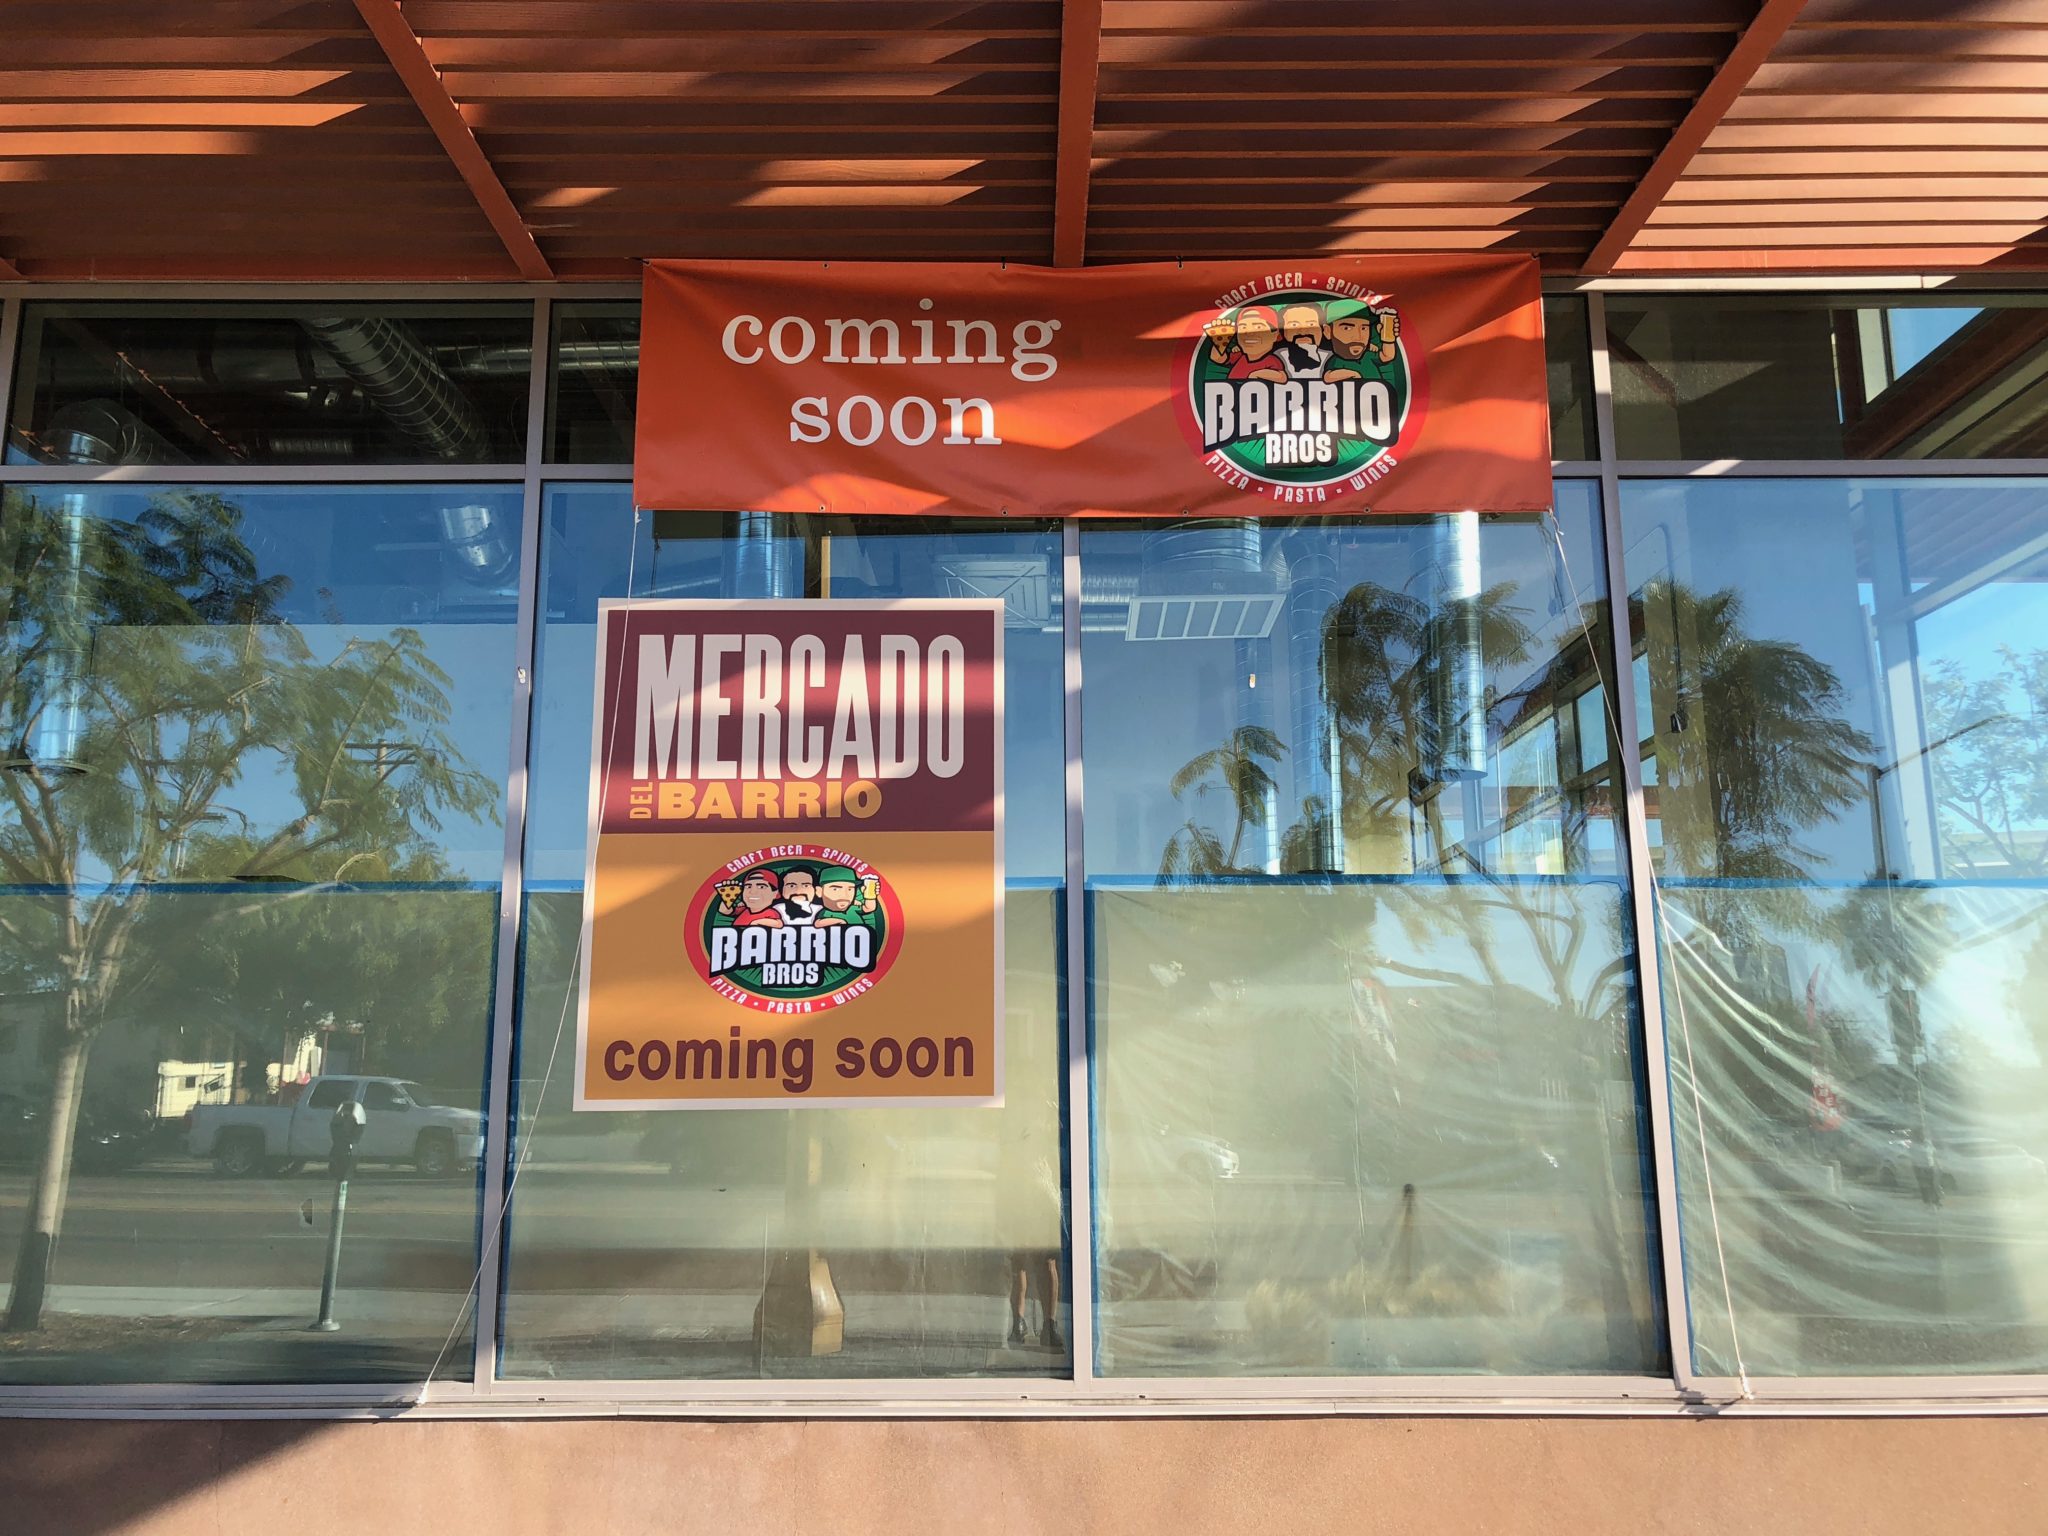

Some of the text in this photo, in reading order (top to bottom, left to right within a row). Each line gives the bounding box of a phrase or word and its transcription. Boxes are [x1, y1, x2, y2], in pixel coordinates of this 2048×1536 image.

[1214, 272, 1383, 309] CRAFT BEER SPIRITS
[722, 298, 1061, 382] coming
[789, 394, 1002, 447] soon
[1204, 380, 1392, 447] BARRIO
[1265, 433, 1332, 465] BROS
[1205, 454, 1398, 503] PIZZA PASTA WINGS
[632, 634, 965, 780] MERCADO
[629, 780, 882, 819] DEL BARRIO
[726, 844, 869, 873] CRAFT BEER SPIRITS
[710, 925, 871, 973] BARRIO
[710, 977, 874, 1014] PIZZA PASTA WINGS
[762, 962, 819, 985] BROS
[604, 1026, 975, 1093] coming soon
